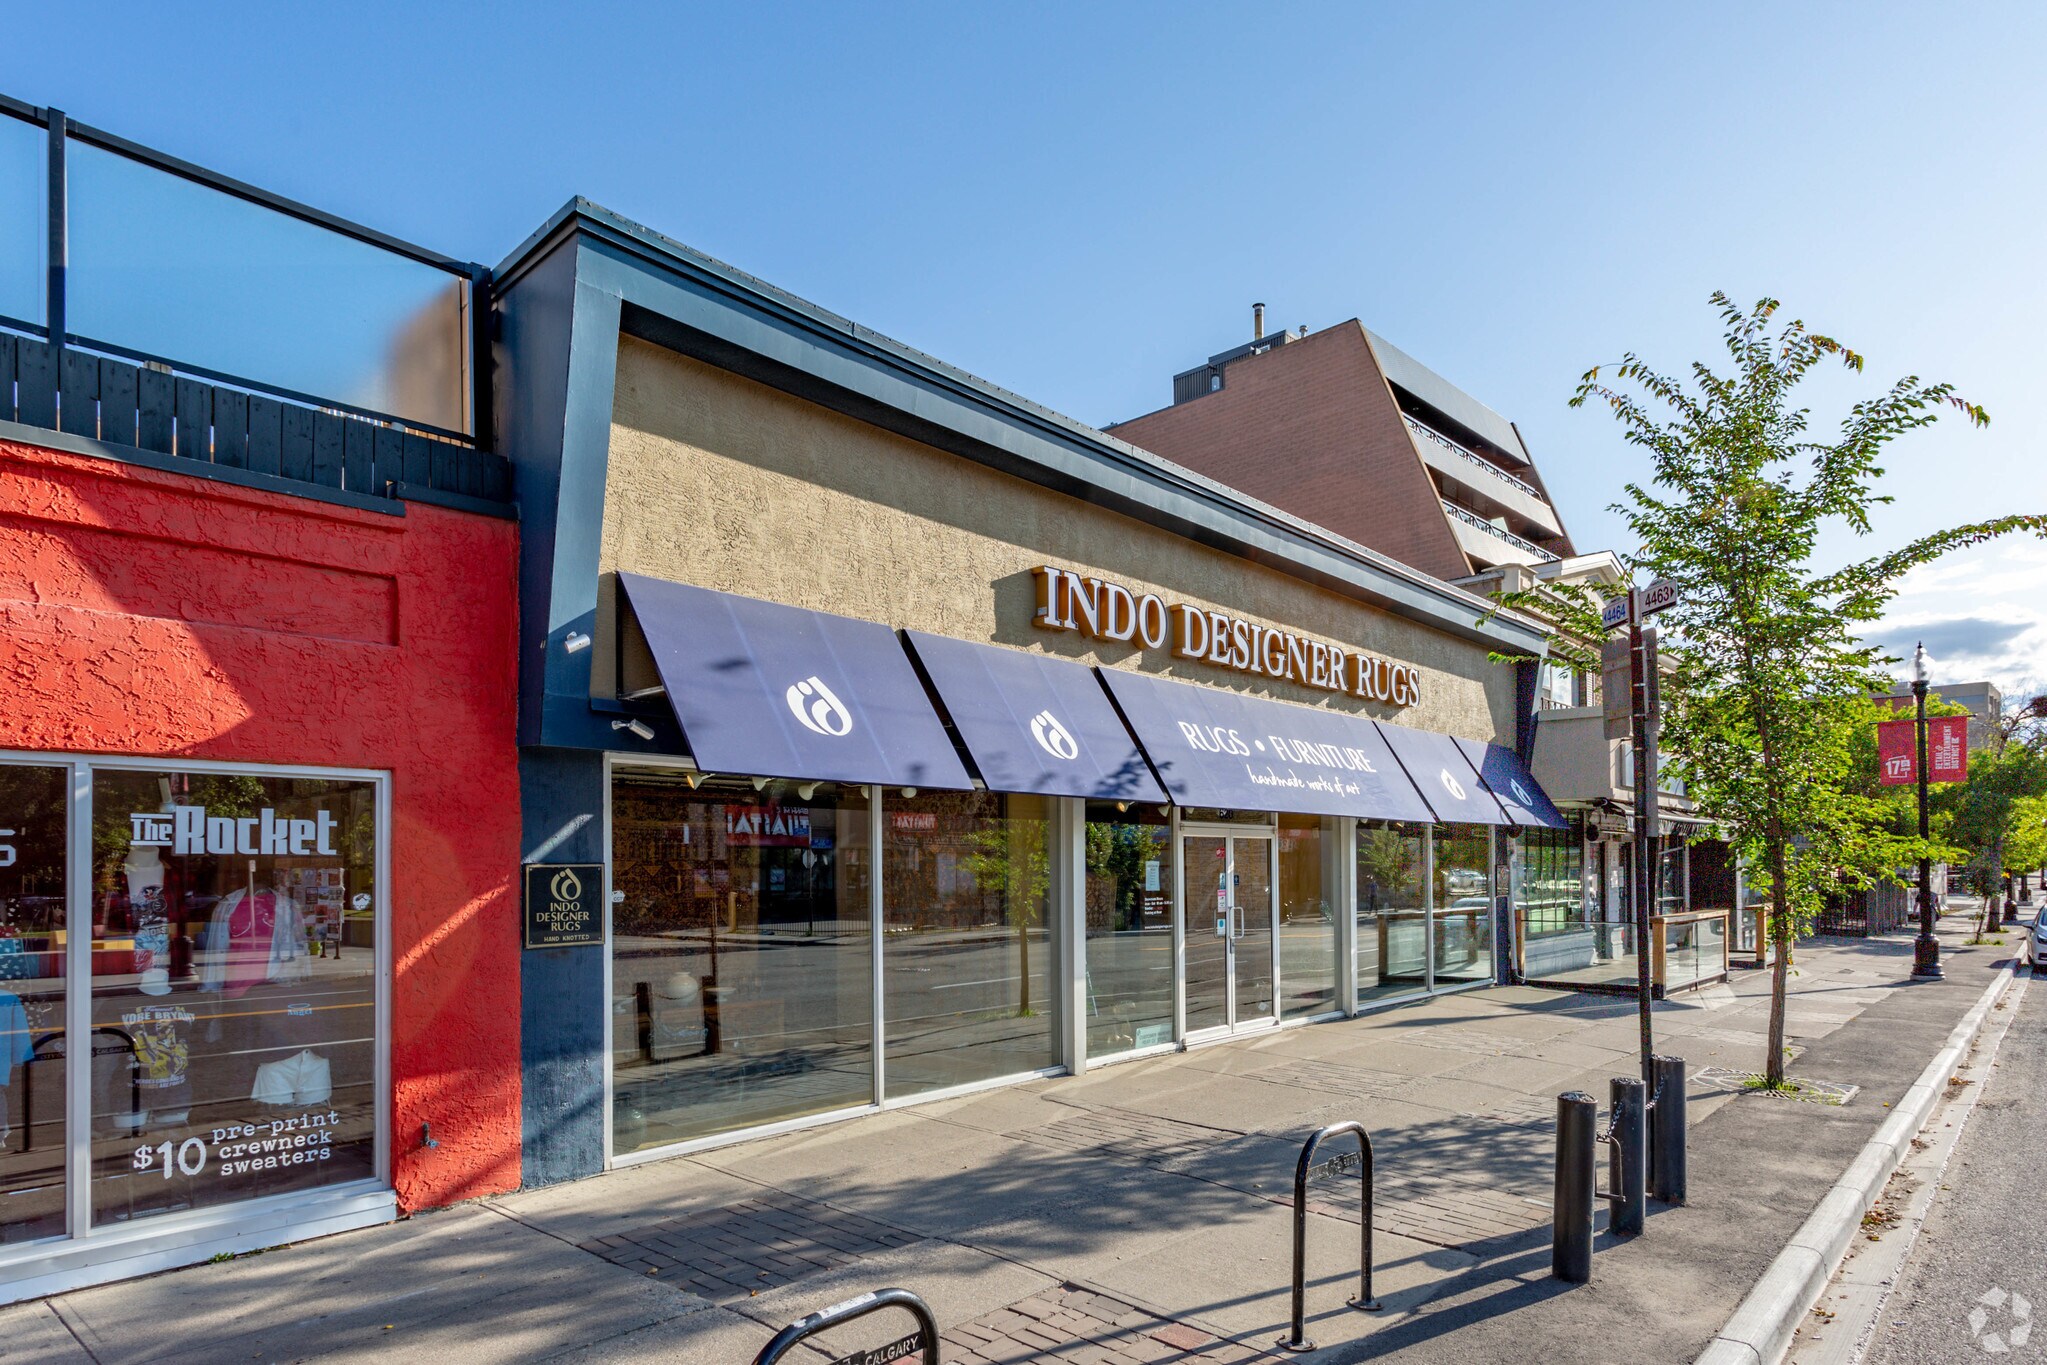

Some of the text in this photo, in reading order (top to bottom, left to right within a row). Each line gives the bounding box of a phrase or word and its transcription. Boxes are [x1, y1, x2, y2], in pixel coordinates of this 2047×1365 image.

[1645, 586, 1670, 607] 4463
[1606, 603, 1626, 622] 4464
[1042, 565, 1421, 708] INDO DESIGNER RUGS
[1178, 721, 1377, 773] RUGS FURNITURE
[1246, 764, 1361, 798] handmade works of art
[1885, 760, 1901, 775] 17
[130, 806, 338, 855] The Rocket
[536, 911, 590, 922] DESIGNER
[550, 901, 581, 911] INDO
[551, 921, 581, 931] RUGS
[211, 1110, 340, 1145] pre-print
[133, 1137, 207, 1180] $10
[219, 1129, 333, 1159] crewneck
[220, 1147, 331, 1176] sweaters
[865, 1335, 919, 1365] CALGARY
